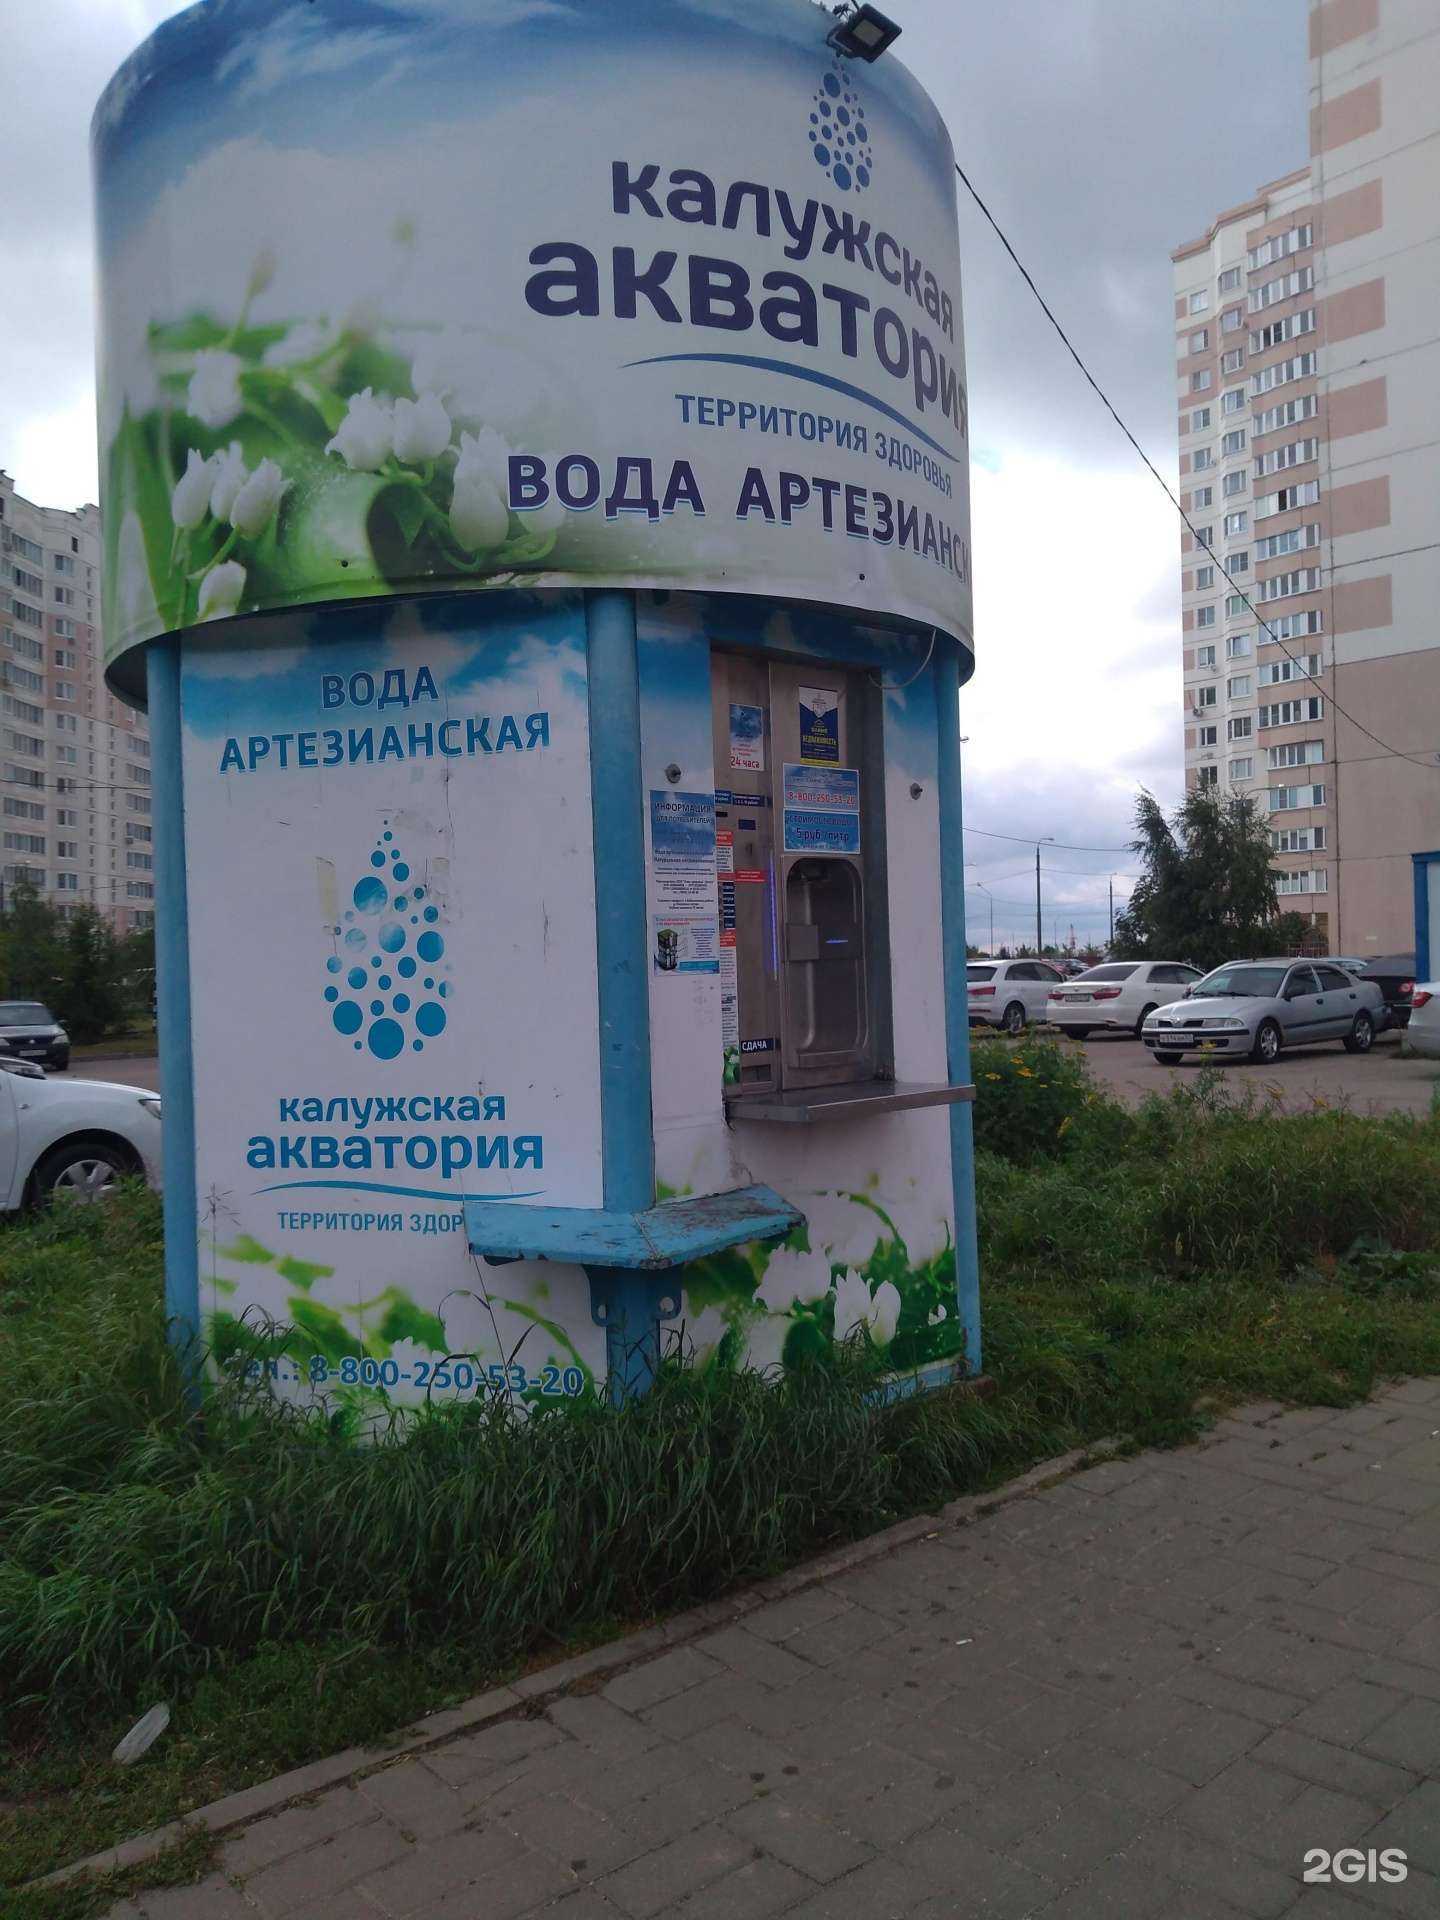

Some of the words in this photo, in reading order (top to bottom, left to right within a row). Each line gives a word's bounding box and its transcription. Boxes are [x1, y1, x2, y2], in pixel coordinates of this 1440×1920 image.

[611, 160, 954, 343] калужская
[524, 241, 969, 440] акватория
[675, 394, 868, 454] ТЕРРИТОРИЯ
[875, 432, 953, 500] ЗДОРОВЬЯ
[508, 454, 705, 522] ВОДА
[321, 665, 439, 711] ВОДА
[219, 711, 551, 775] АРТЕЗИАНСКАЯ
[730, 755, 742, 767] 24
[655, 802, 714, 813] ИНФОРМАЦИЯ
[741, 1040, 768, 1052] СДАЧА
[279, 1095, 506, 1129] калужская
[246, 1134, 544, 1178] акватория
[277, 1211, 403, 1231] ТЕРРИТОРИЯ
[308, 1354, 584, 1396] 8-800-250-53-20
